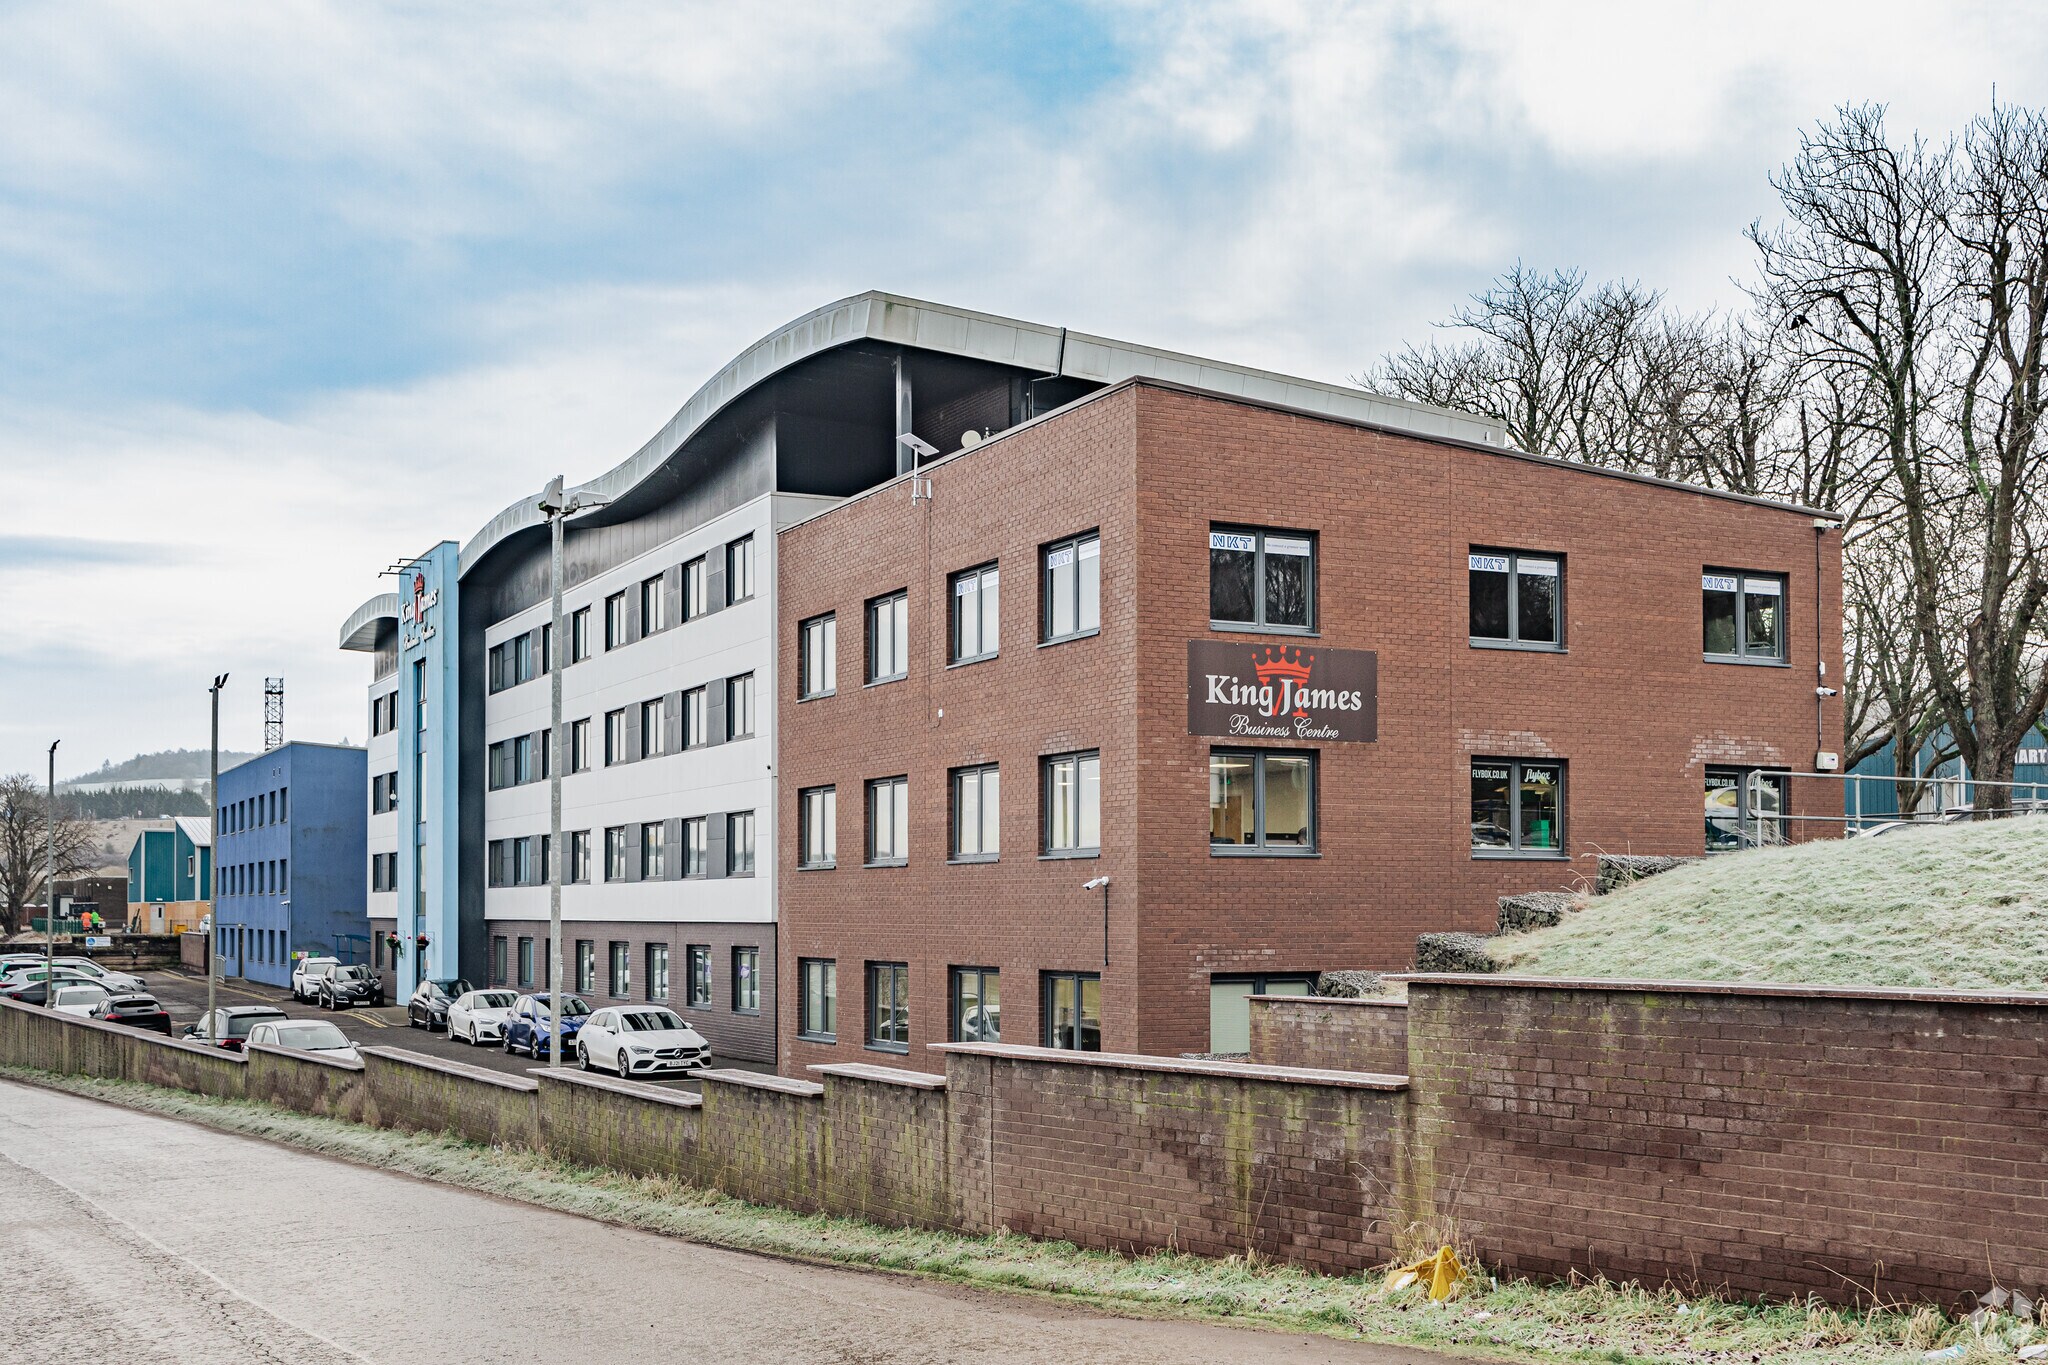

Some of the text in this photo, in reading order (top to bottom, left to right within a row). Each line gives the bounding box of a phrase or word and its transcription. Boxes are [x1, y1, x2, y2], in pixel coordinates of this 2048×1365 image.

[1213, 534, 1252, 549] NKT
[1050, 550, 1072, 567] NKT
[1471, 556, 1505, 570] NKT
[1703, 576, 1734, 589] NKT
[1205, 674, 1362, 717] King James
[1229, 713, 1339, 739] Business Centre
[1472, 769, 1508, 779] FLYBOX.CO.UK
[1524, 768, 1551, 783] flybox
